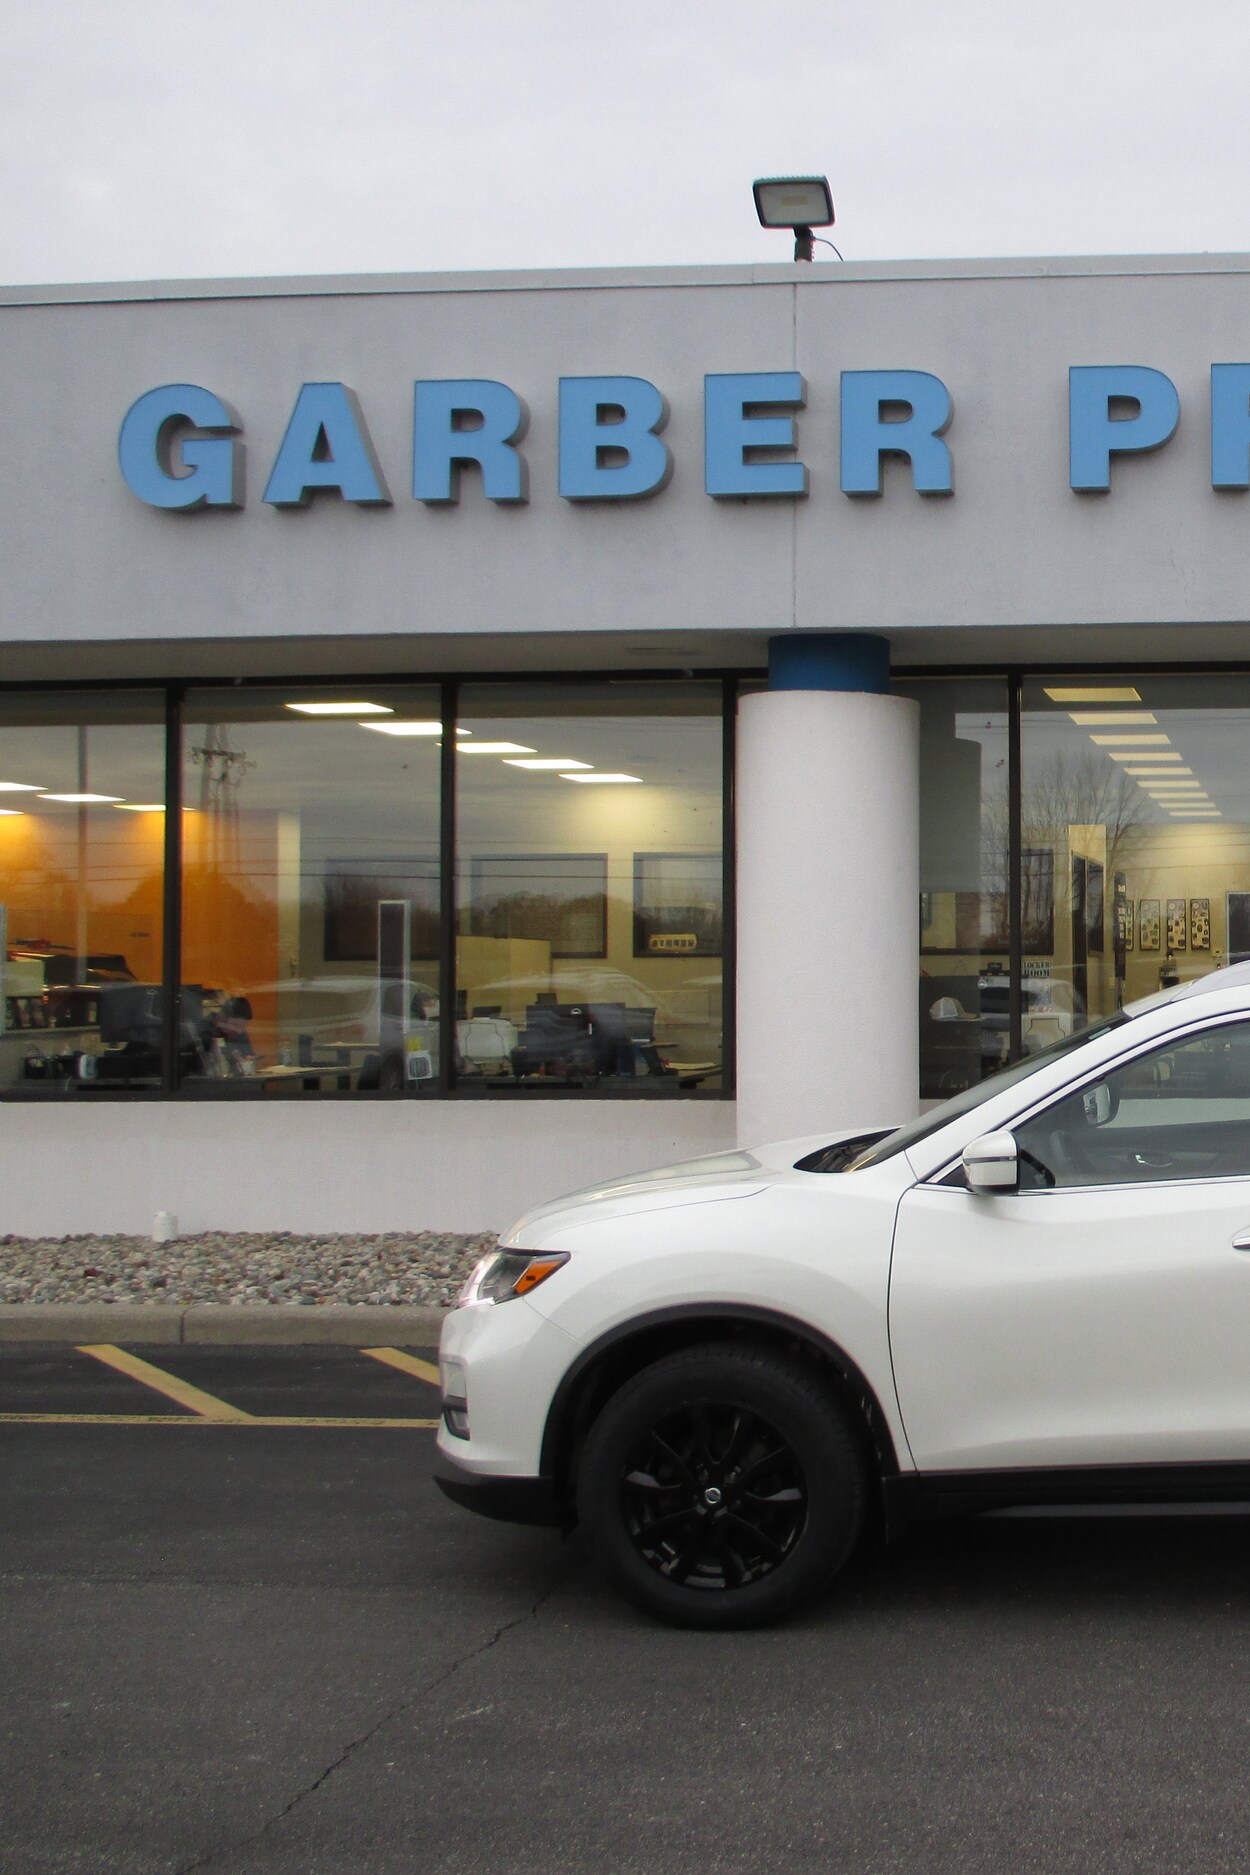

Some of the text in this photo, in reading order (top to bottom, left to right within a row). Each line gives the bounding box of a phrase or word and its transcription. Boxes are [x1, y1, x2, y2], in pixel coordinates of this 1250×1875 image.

[118, 370, 956, 513] GARBER
[1023, 961, 1050, 969] LOCKER
[1023, 969, 1050, 977] ROOM
